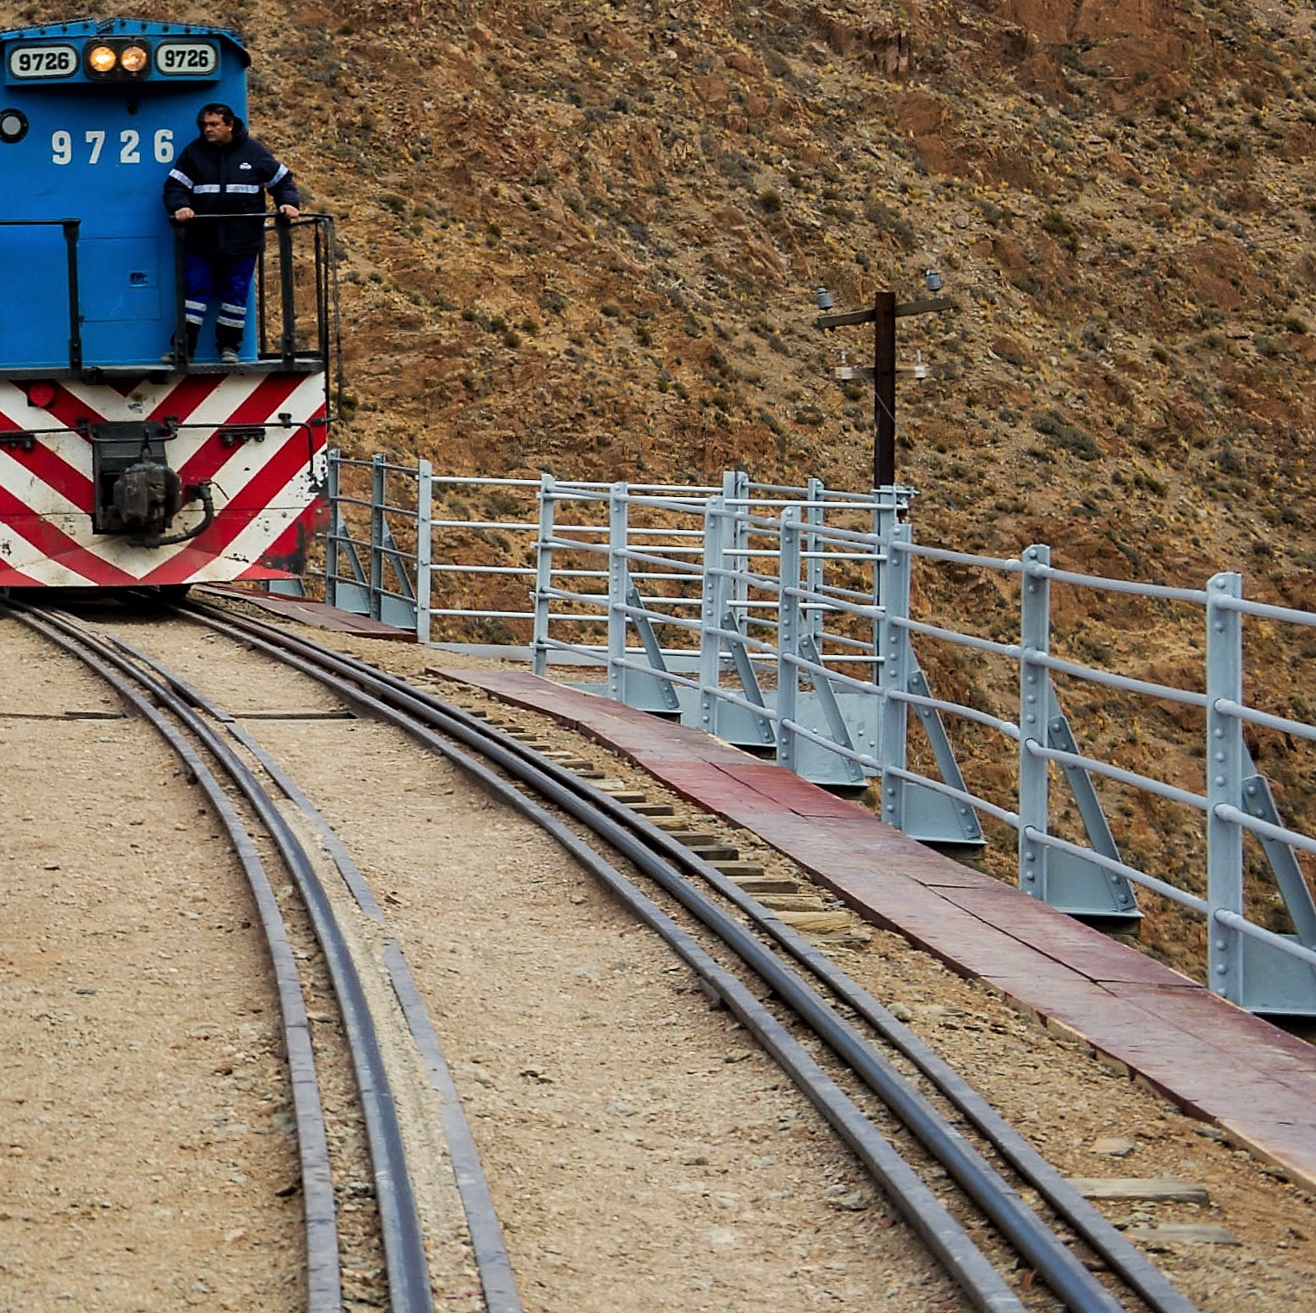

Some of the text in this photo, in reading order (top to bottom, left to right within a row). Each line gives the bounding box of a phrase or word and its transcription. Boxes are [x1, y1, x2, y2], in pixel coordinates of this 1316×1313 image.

[19, 52, 69, 71] 9726
[165, 50, 209, 67] 9726
[51, 129, 174, 164] 9726
